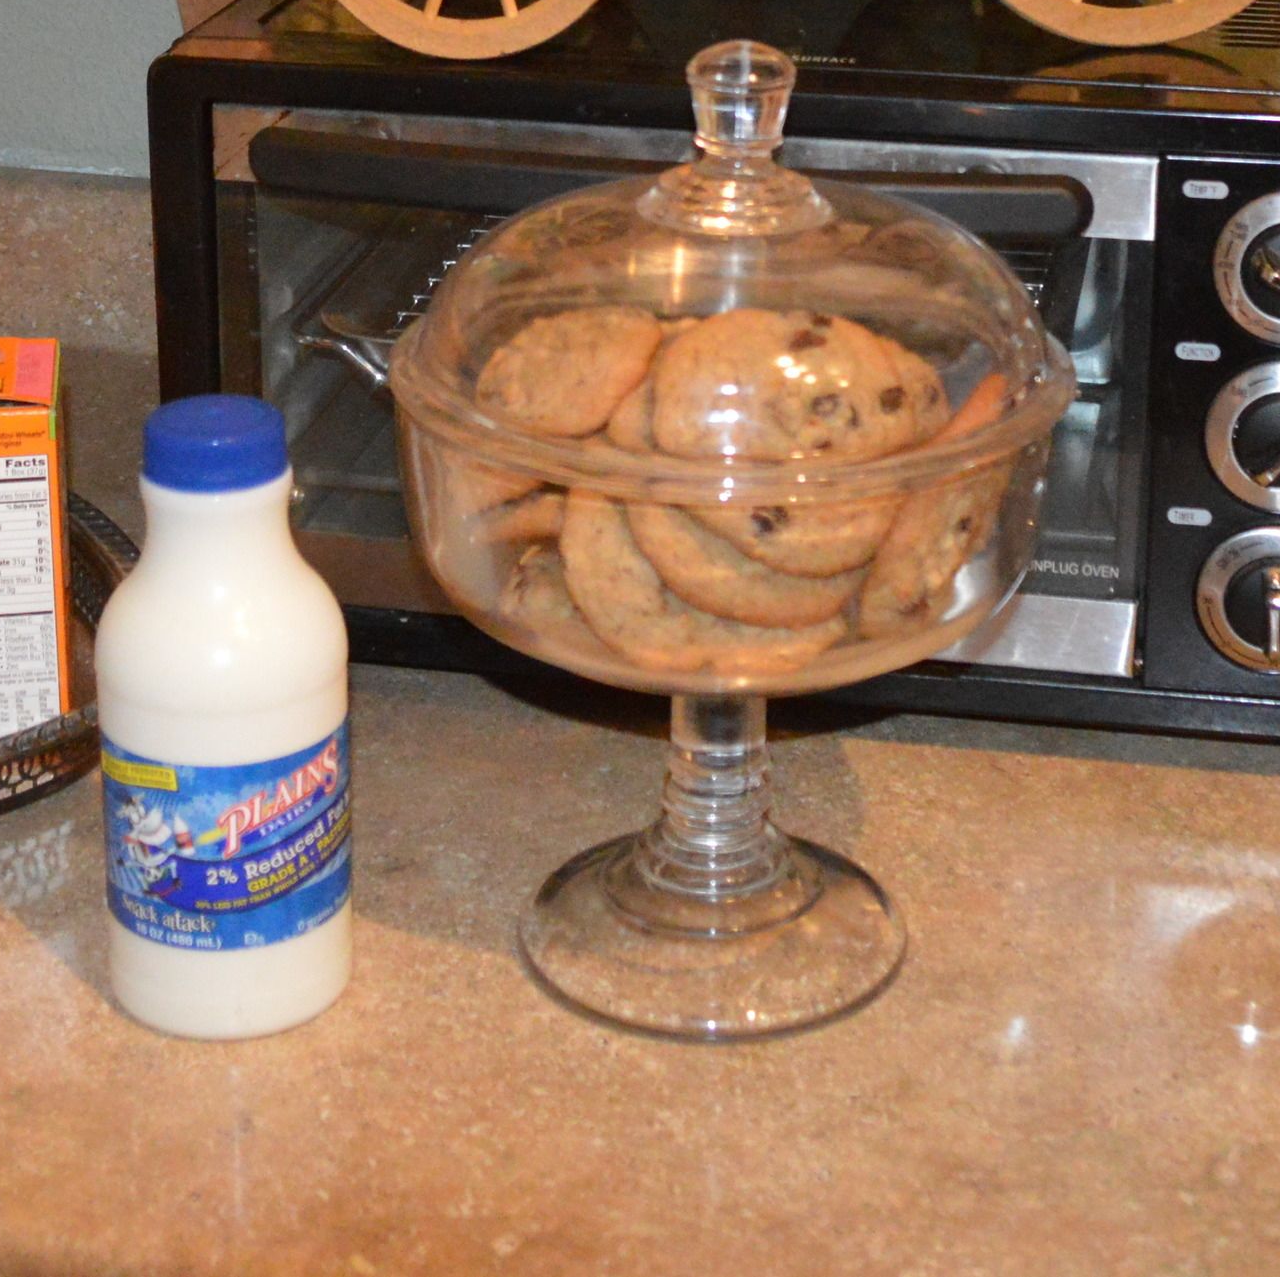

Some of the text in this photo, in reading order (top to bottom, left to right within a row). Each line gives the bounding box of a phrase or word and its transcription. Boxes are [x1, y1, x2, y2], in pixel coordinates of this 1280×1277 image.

[791, 54, 857, 65] SURFACE
[5, 457, 47, 469] Facts
[1081, 564, 1120, 579] OVEN
[217, 738, 338, 860] PLAINS
[259, 799, 315, 837] DAIRY
[206, 866, 239, 887] 2%
[243, 820, 325, 881] Reduced
[247, 854, 310, 893] GRADE A
[162, 910, 213, 934] attack
